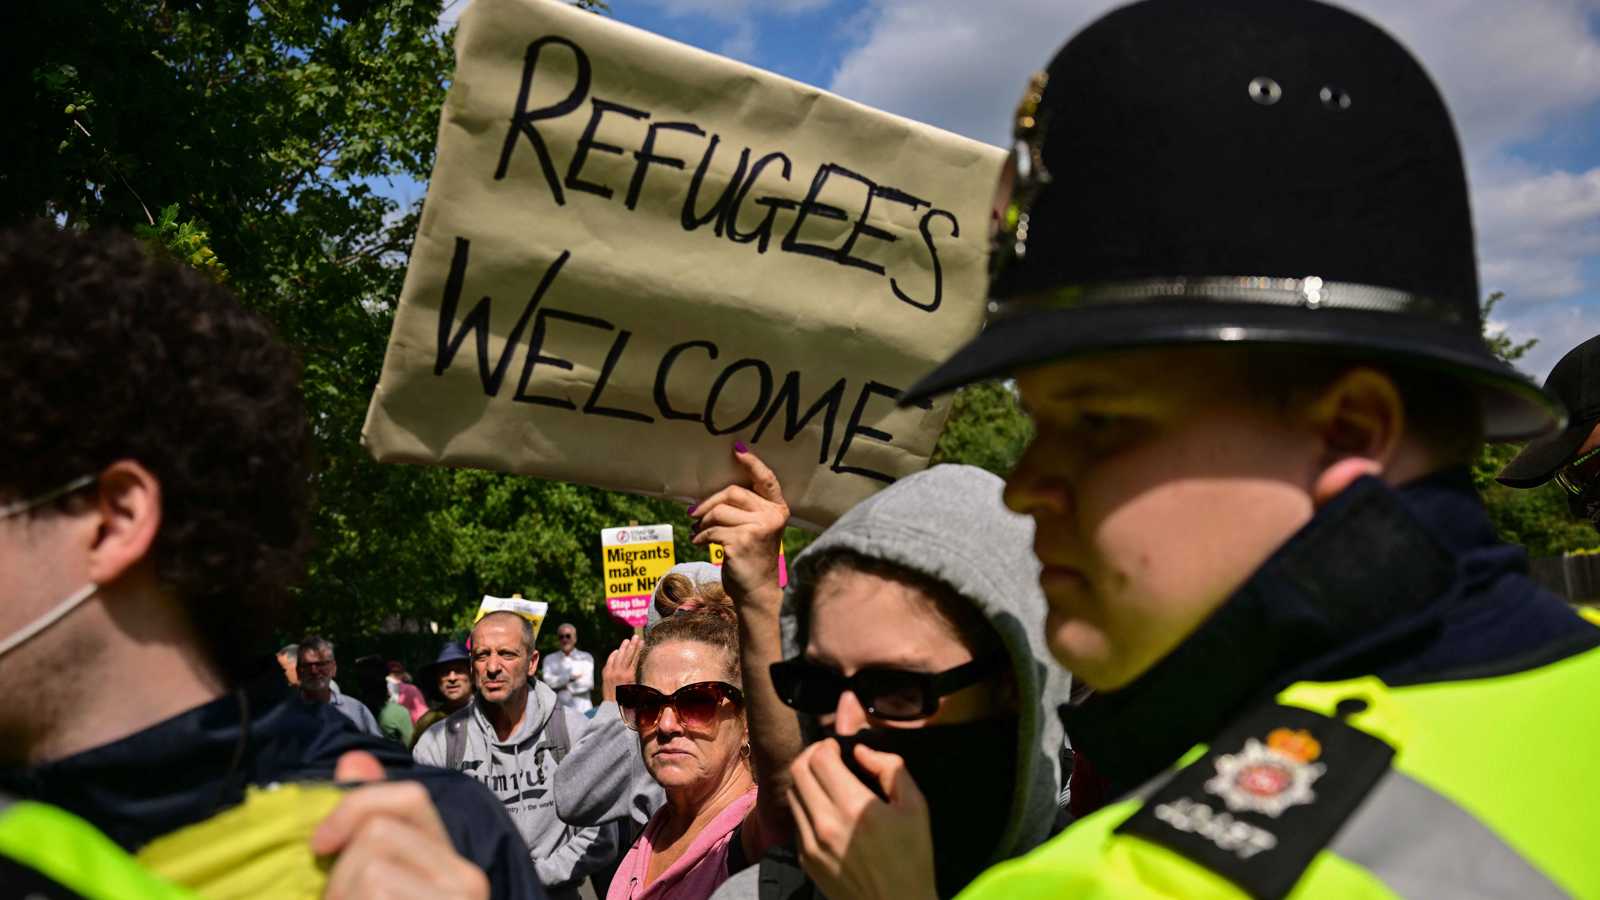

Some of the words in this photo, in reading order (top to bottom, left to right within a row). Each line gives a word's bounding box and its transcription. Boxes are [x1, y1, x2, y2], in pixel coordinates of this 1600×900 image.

[493, 35, 958, 312] REFUGEES
[433, 236, 933, 484] WELCOME
[607, 546, 671, 565] Migrants
[609, 564, 647, 578] make
[610, 582, 633, 593] our
[610, 599, 631, 609] Stop
[631, 598, 646, 608] the
